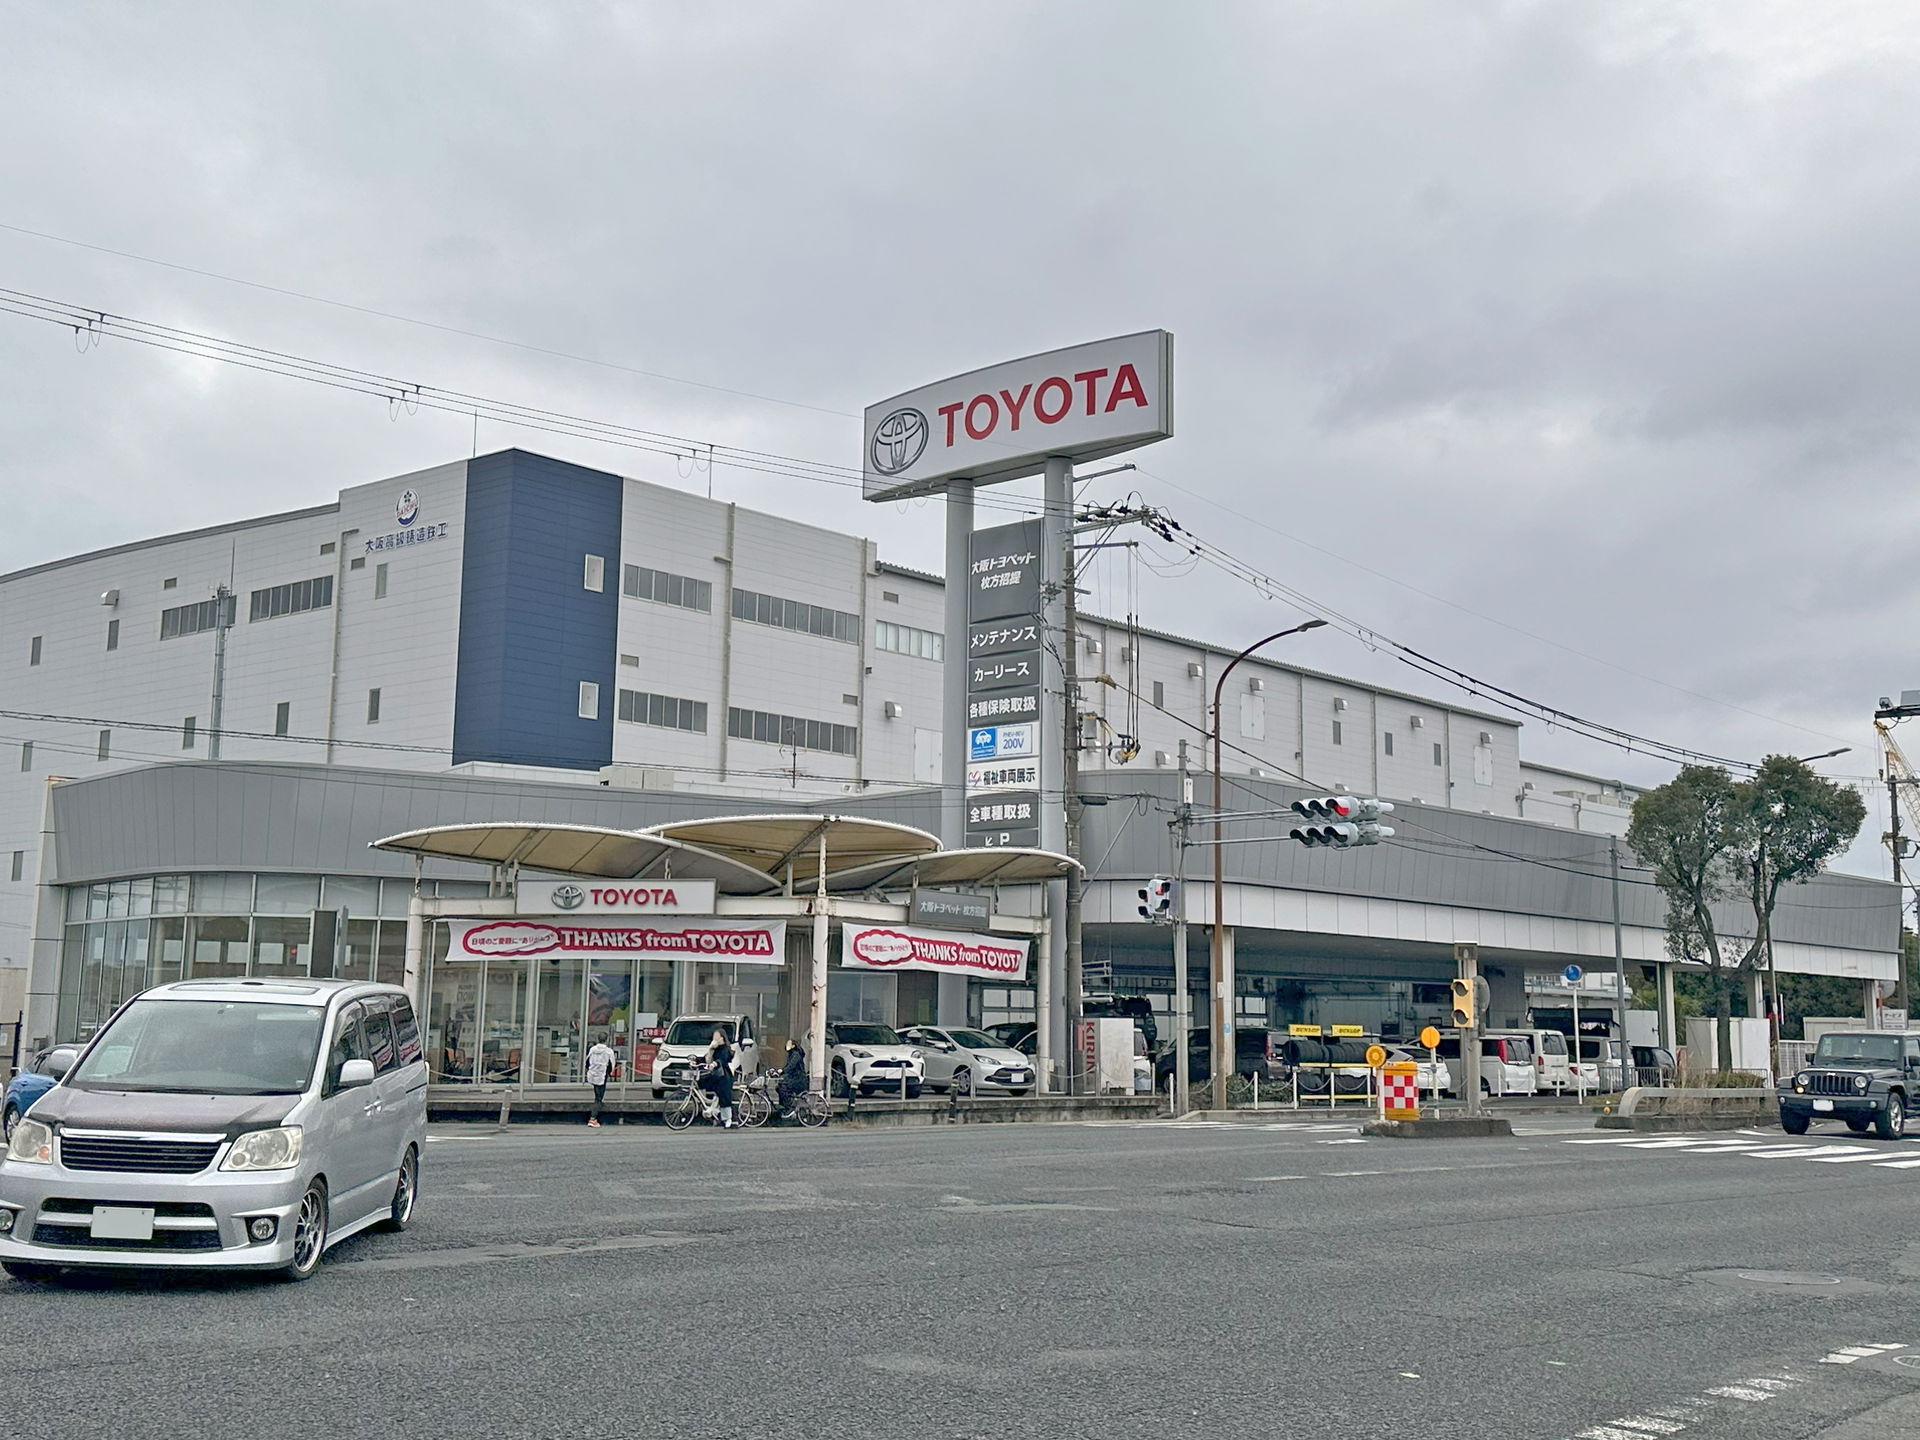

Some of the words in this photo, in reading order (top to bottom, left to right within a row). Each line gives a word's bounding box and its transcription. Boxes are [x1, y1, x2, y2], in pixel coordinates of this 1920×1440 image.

[938, 363, 1149, 447] TOYOTA
[971, 552, 1037, 575] 大阪トヨペット
[980, 570, 1022, 590] 枚方招提
[970, 626, 1037, 649] メンテナンス
[974, 661, 1030, 682] カーリース
[969, 696, 1036, 719] 各種保険取扱
[1003, 738, 1024, 749] 200V
[983, 767, 1036, 785] 福祉車両展示
[970, 804, 1031, 823] 全車種取扱
[1000, 833, 1010, 845] P
[590, 889, 678, 906] TOYOTA
[920, 901, 961, 914] 大阪トヨペット
[560, 930, 642, 948] THANKS
[646, 932, 687, 948] from
[687, 933, 770, 951] TOYOTA
[912, 941, 957, 962] THANKS
[958, 947, 980, 963] from
[1086, 1022, 1095, 1073] KIRIN
